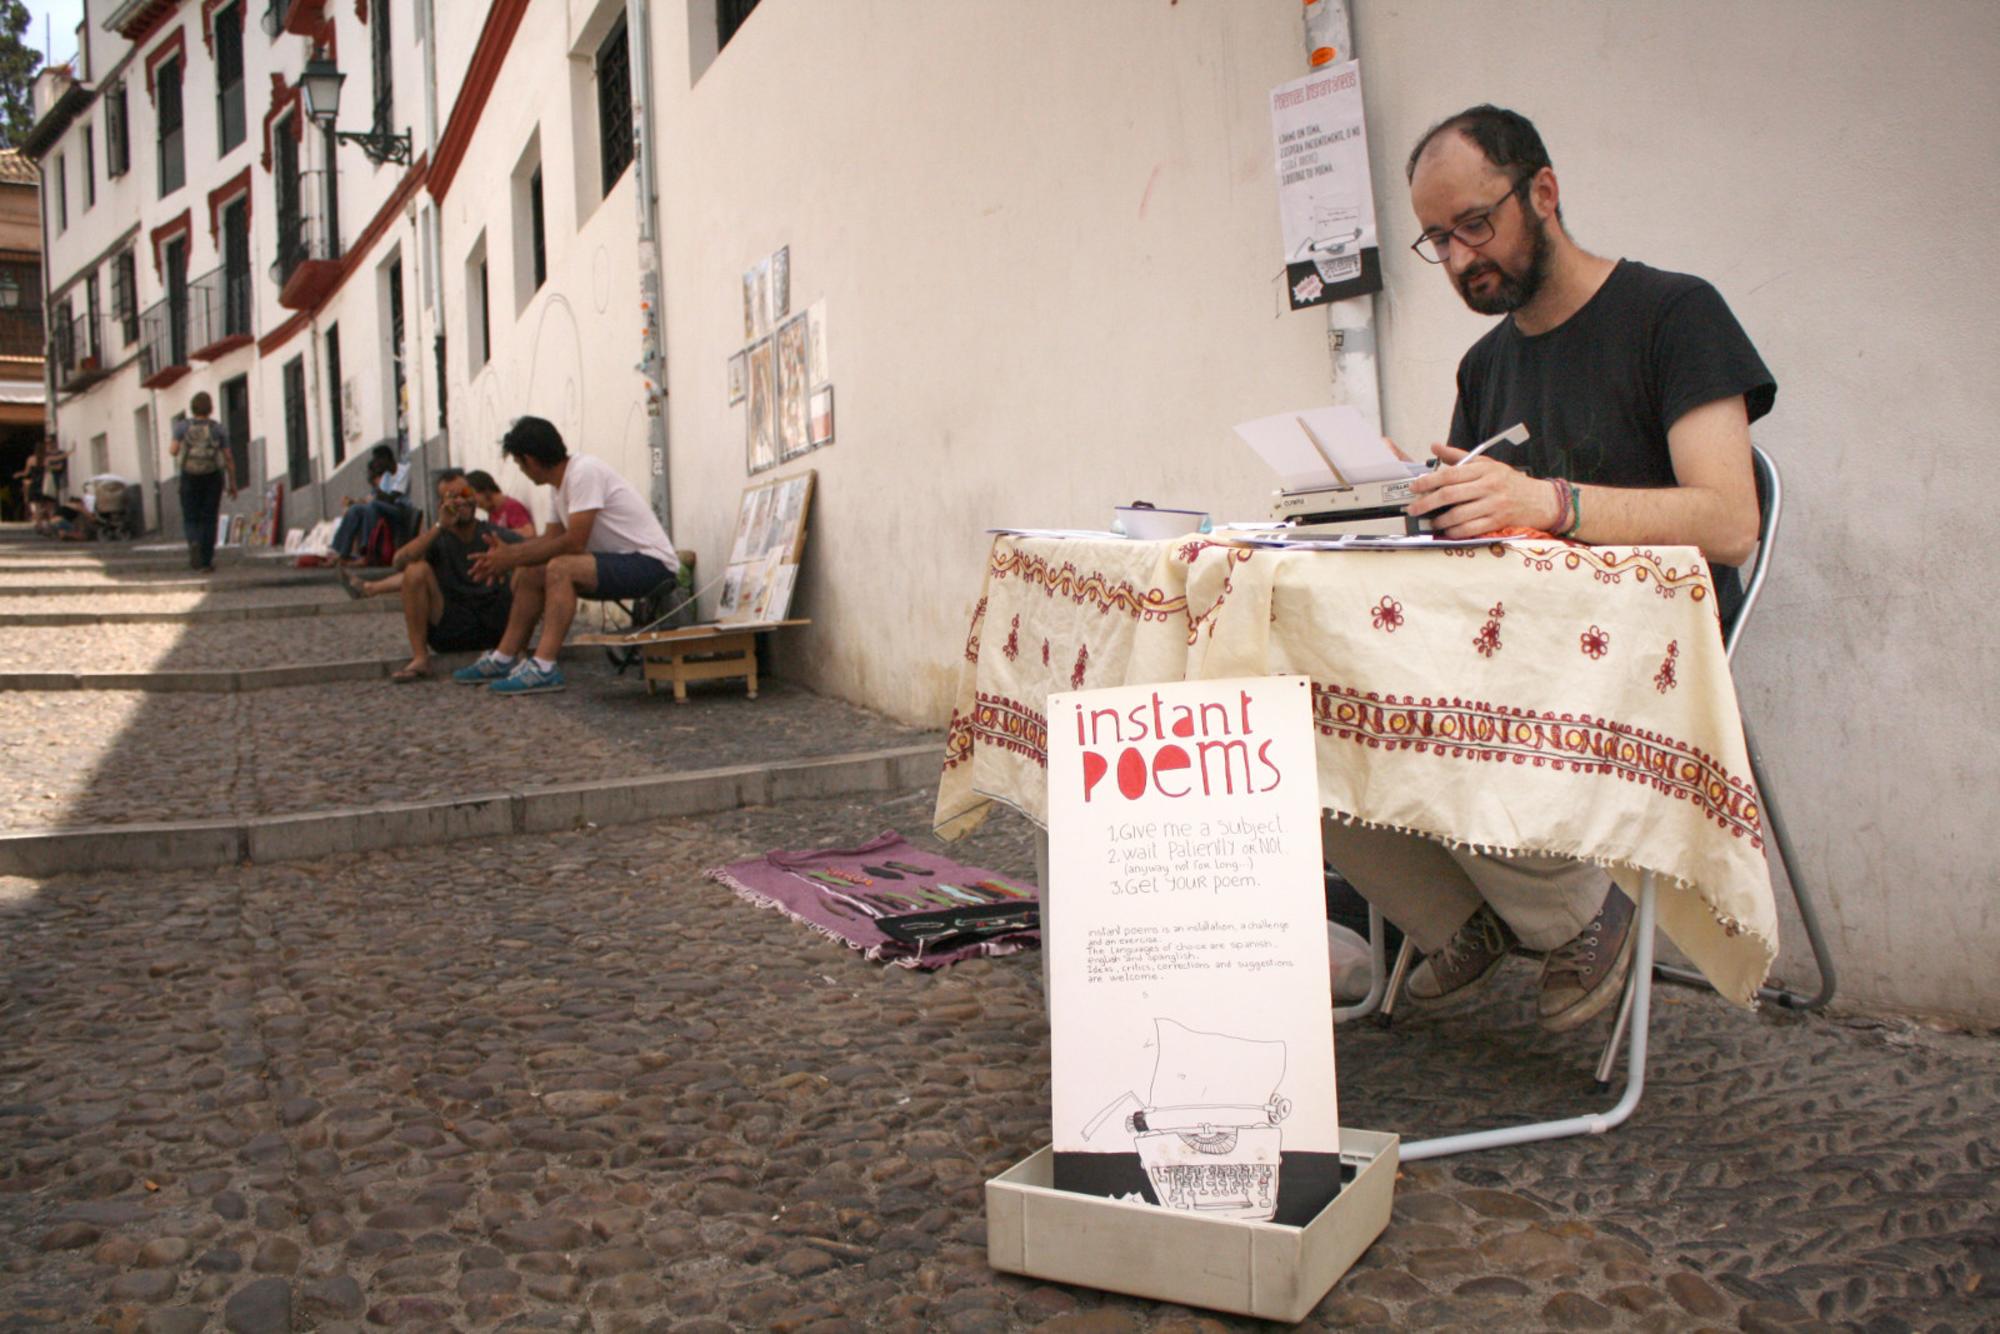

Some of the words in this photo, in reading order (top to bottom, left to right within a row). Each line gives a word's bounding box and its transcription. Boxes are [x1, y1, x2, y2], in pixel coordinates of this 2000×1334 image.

[1075, 690, 1253, 745] instant
[1164, 823, 1192, 837] me
[1200, 822, 1210, 835] a
[1175, 861, 1189, 871] not
[1124, 926, 1159, 937] poems
[1247, 921, 1289, 931] challenge
[1087, 947, 1104, 955] The
[1163, 942, 1172, 951] of
[1126, 954, 1142, 963] and
[1157, 960, 1210, 971] corrections
[1216, 959, 1232, 968] and
[1238, 960, 1294, 970] suggestions
[1088, 975, 1102, 983] are
[1110, 973, 1164, 981] welcome.
